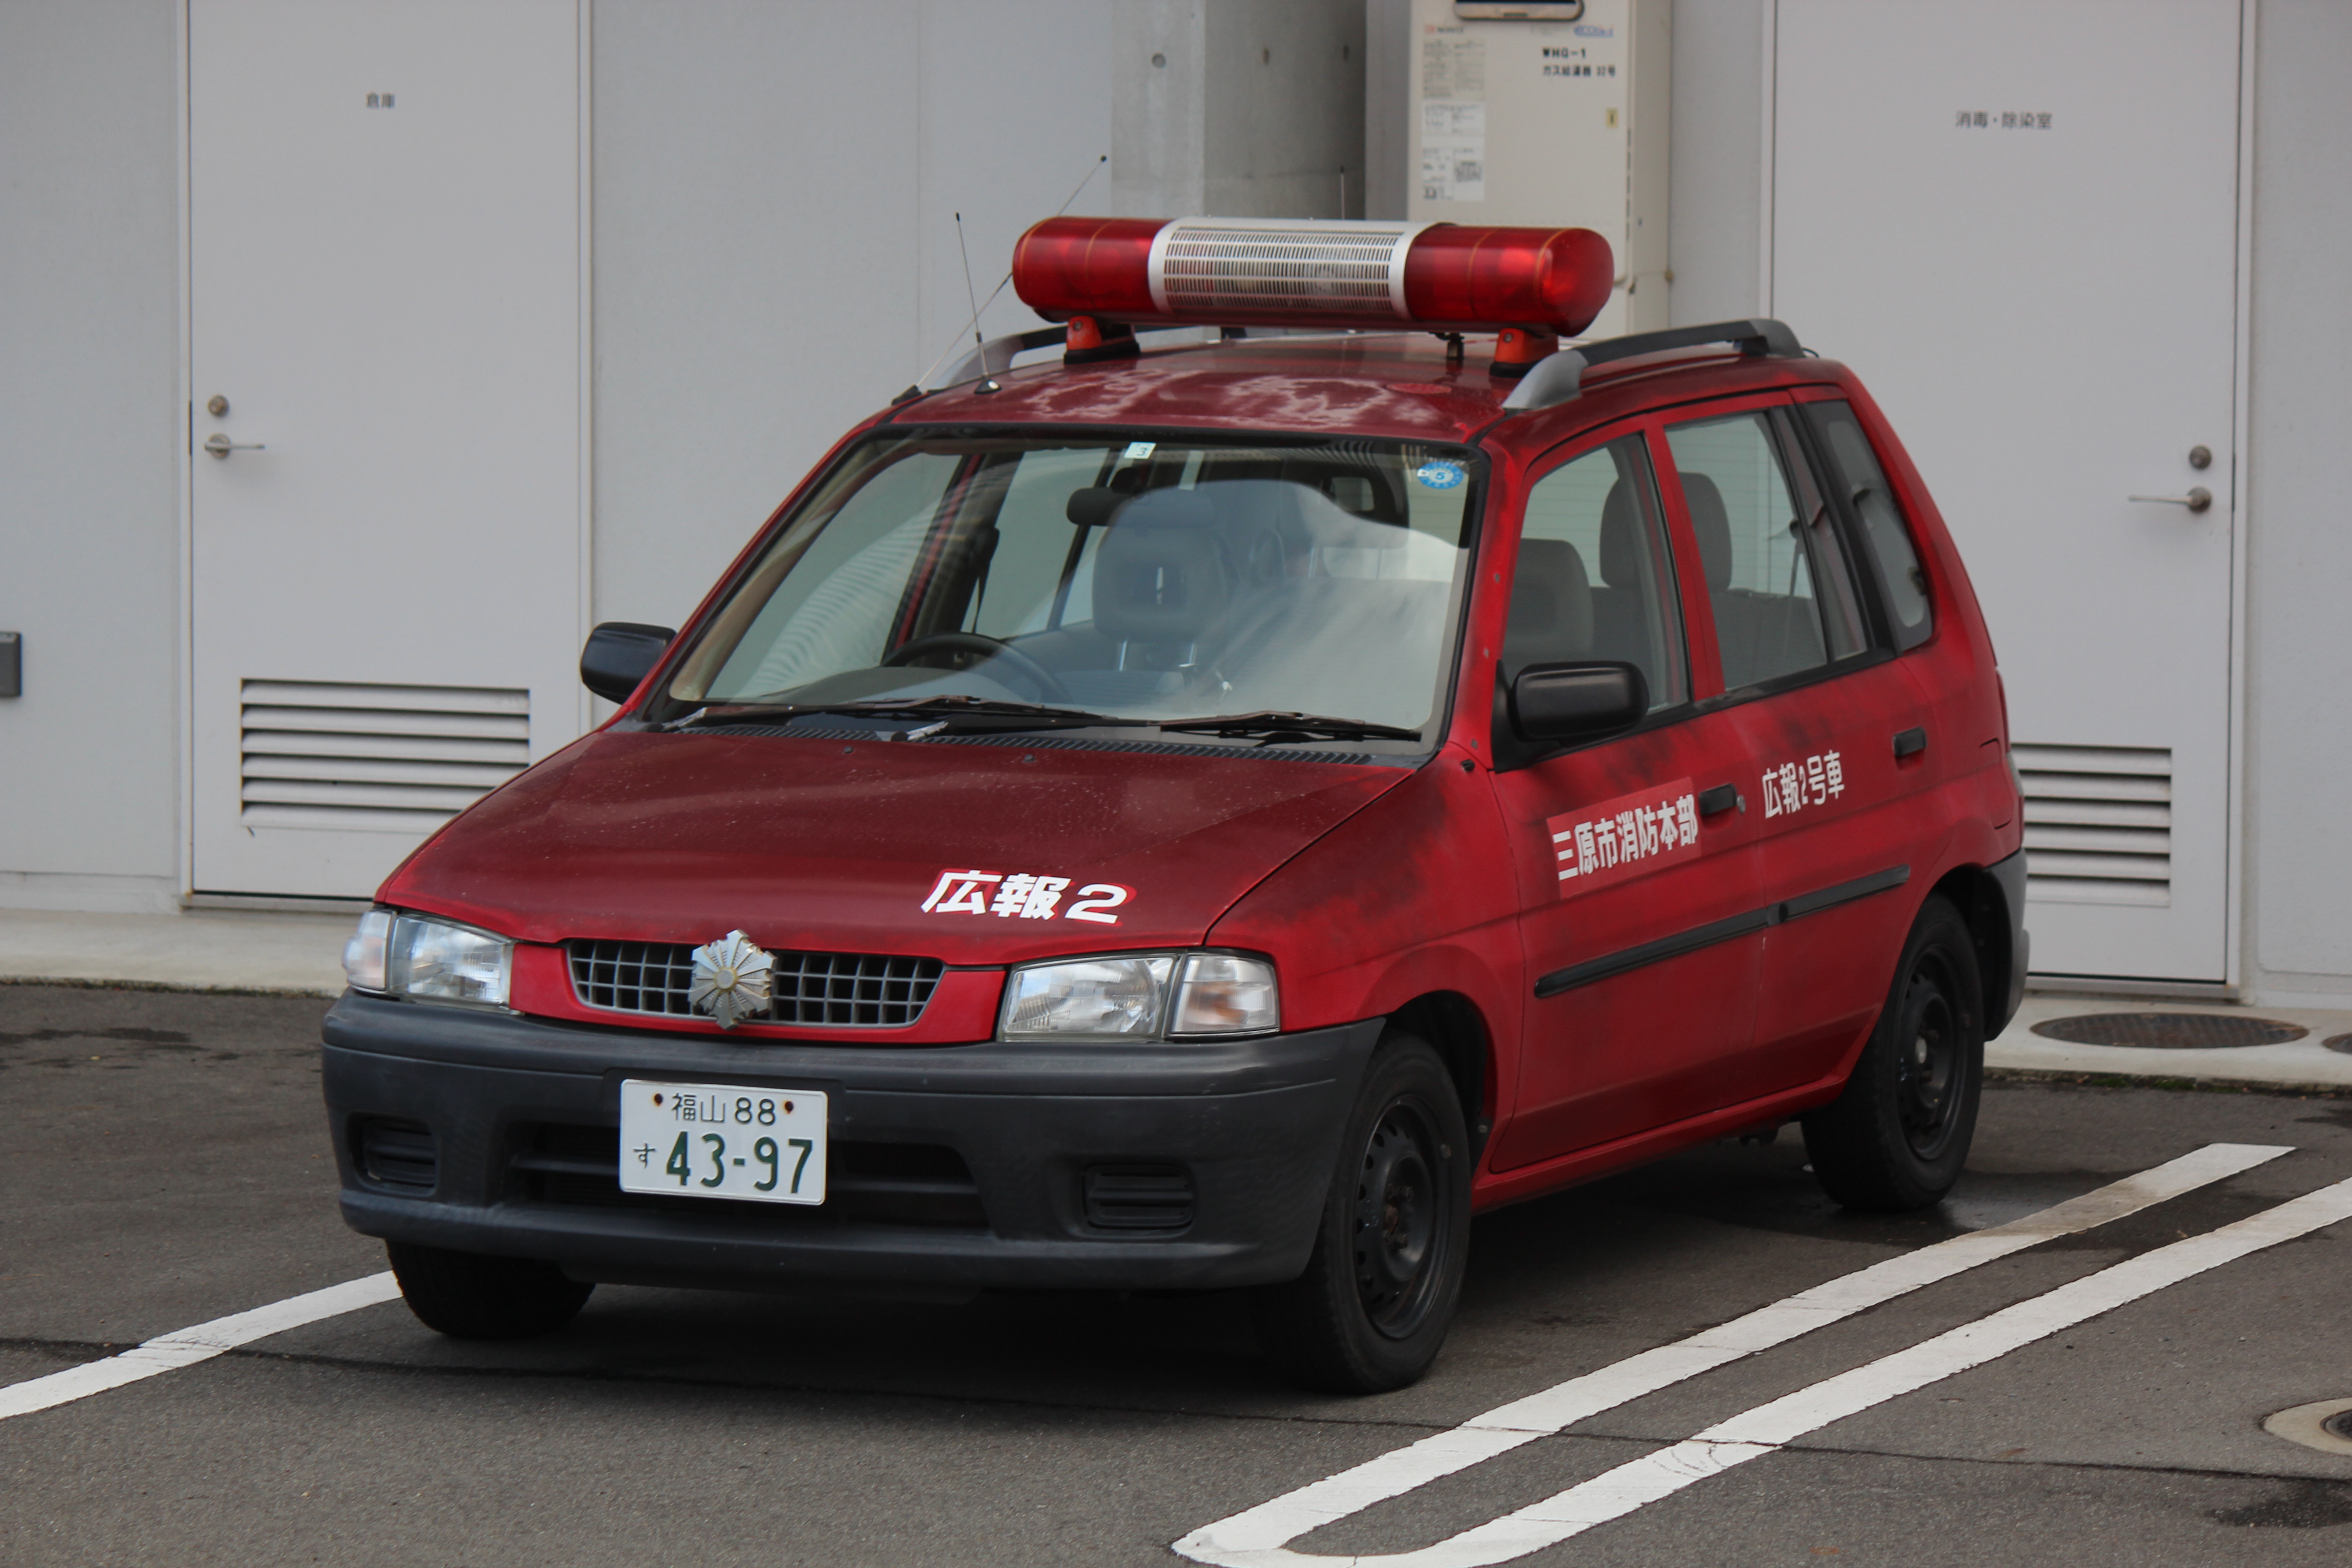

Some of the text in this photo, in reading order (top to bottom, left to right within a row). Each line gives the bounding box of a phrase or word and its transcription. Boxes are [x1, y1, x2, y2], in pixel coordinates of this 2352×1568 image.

[1762, 750, 1845, 818] 広報2号車
[1552, 794, 1699, 881] 三原市消防本部
[921, 870, 1118, 924] 広報2
[672, 1093, 776, 1125] 福山 88
[633, 1131, 813, 1194] す 43-97
